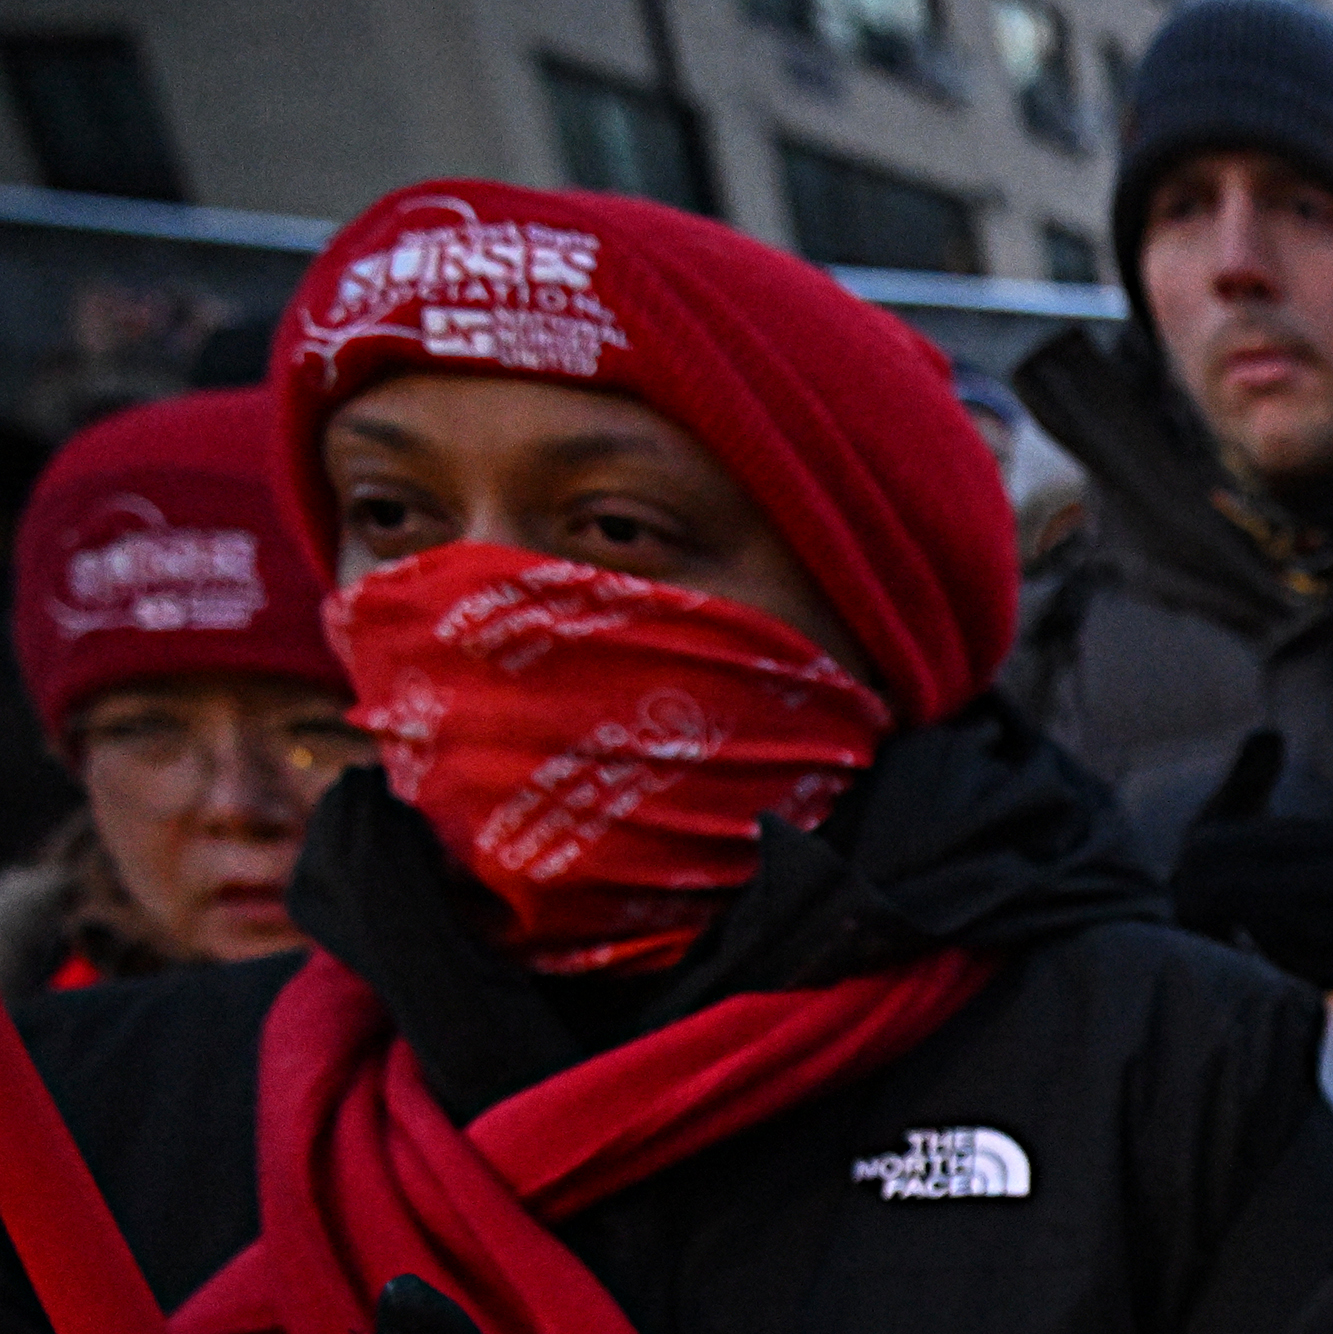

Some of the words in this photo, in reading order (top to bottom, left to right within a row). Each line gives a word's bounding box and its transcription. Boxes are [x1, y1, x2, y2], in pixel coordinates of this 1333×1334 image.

[904, 1127, 976, 1151] THE
[852, 1151, 976, 1184] NORTH
[880, 1174, 972, 1201] FACE
